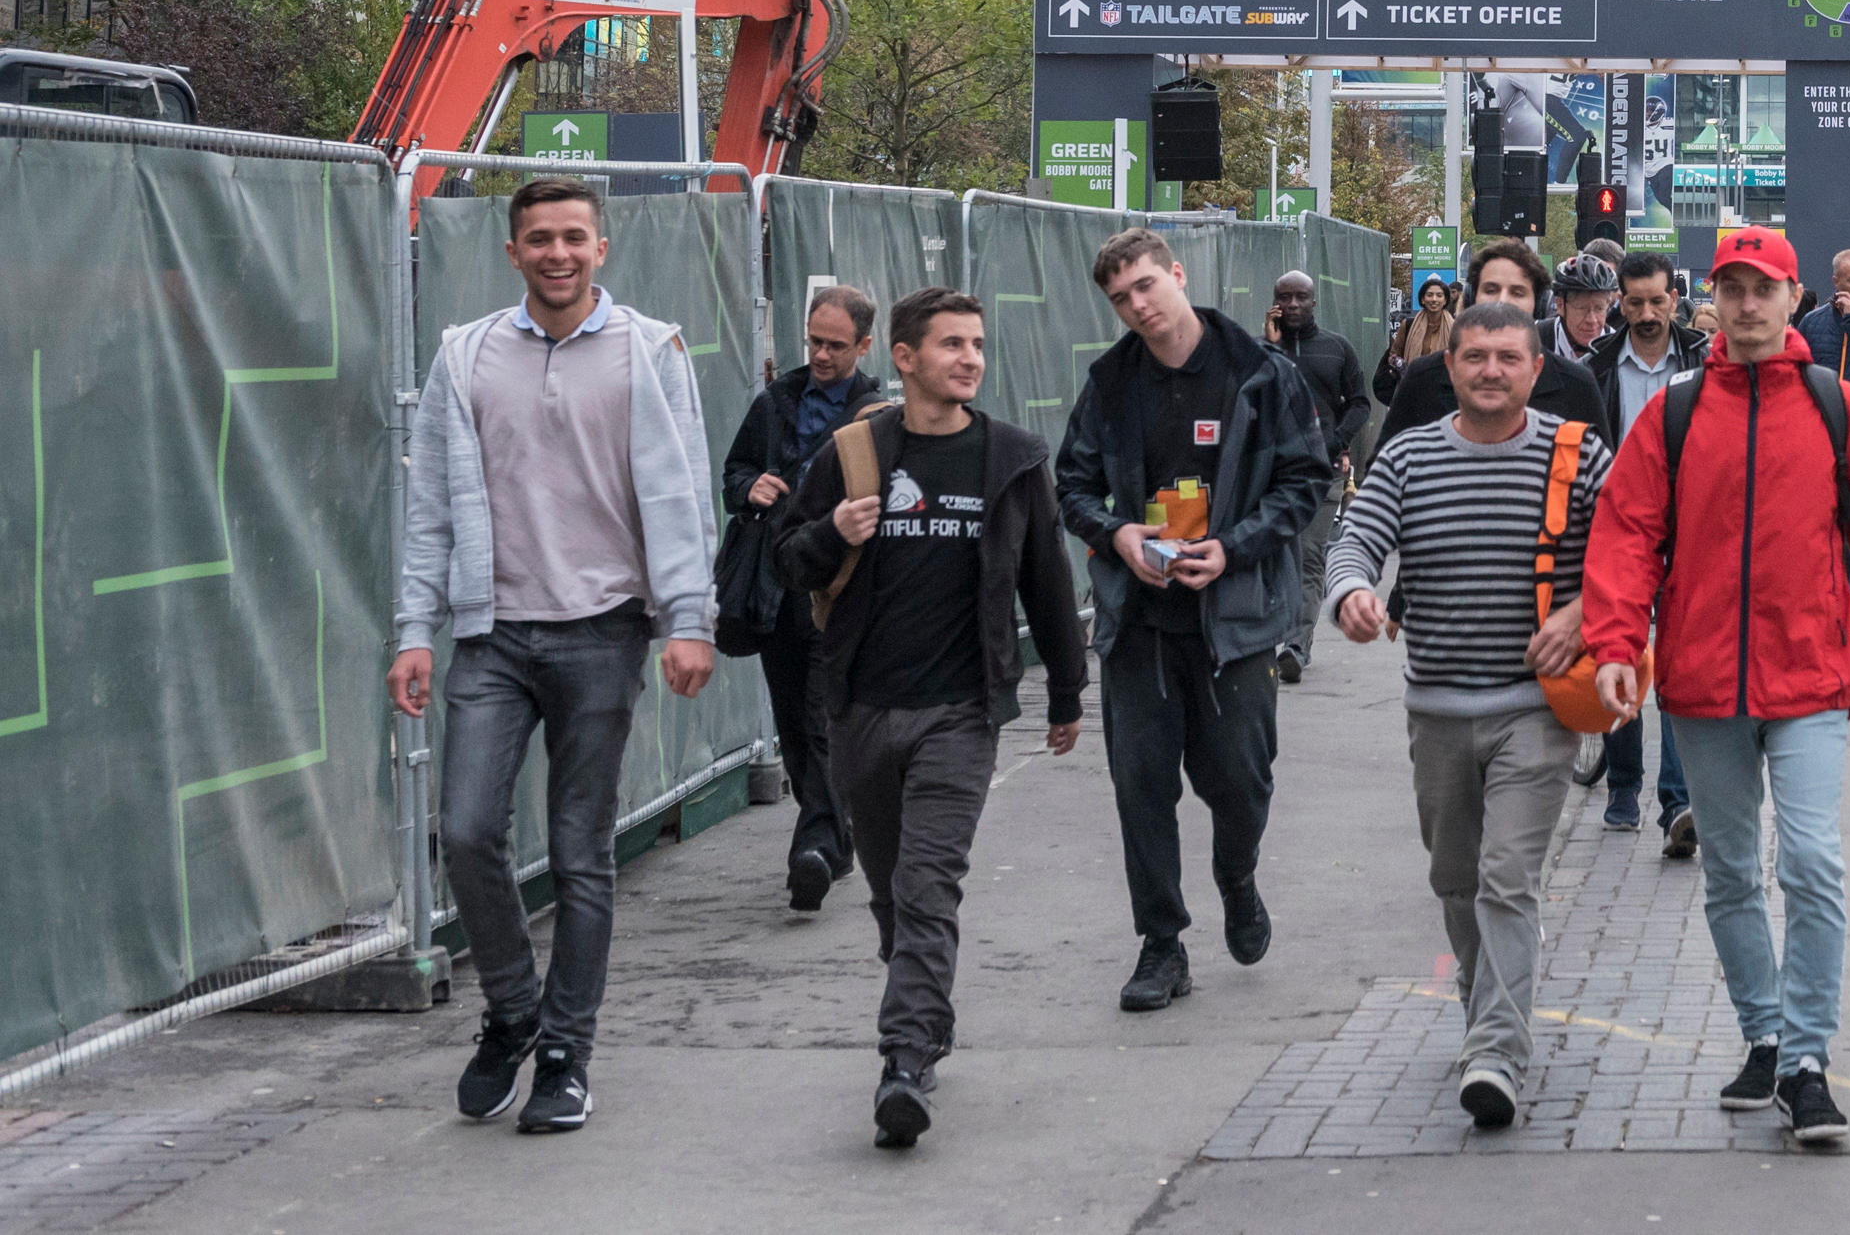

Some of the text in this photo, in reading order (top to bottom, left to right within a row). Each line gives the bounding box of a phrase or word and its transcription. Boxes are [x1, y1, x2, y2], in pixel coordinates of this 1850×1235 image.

[1104, 5, 1242, 25] NFL TAILGATE
[1245, 12, 1310, 25] SUBWAY
[1387, 6, 1562, 25] TICKET OFFICE
[1804, 86, 1835, 98] ENTER
[1811, 102, 1837, 113] YOUR
[1818, 117, 1843, 128] ZONE
[1052, 143, 1112, 158] GREEN
[1045, 165, 1112, 176] BOBBY MOORE
[1090, 179, 1112, 190] GATE
[930, 519, 960, 537] FOR
